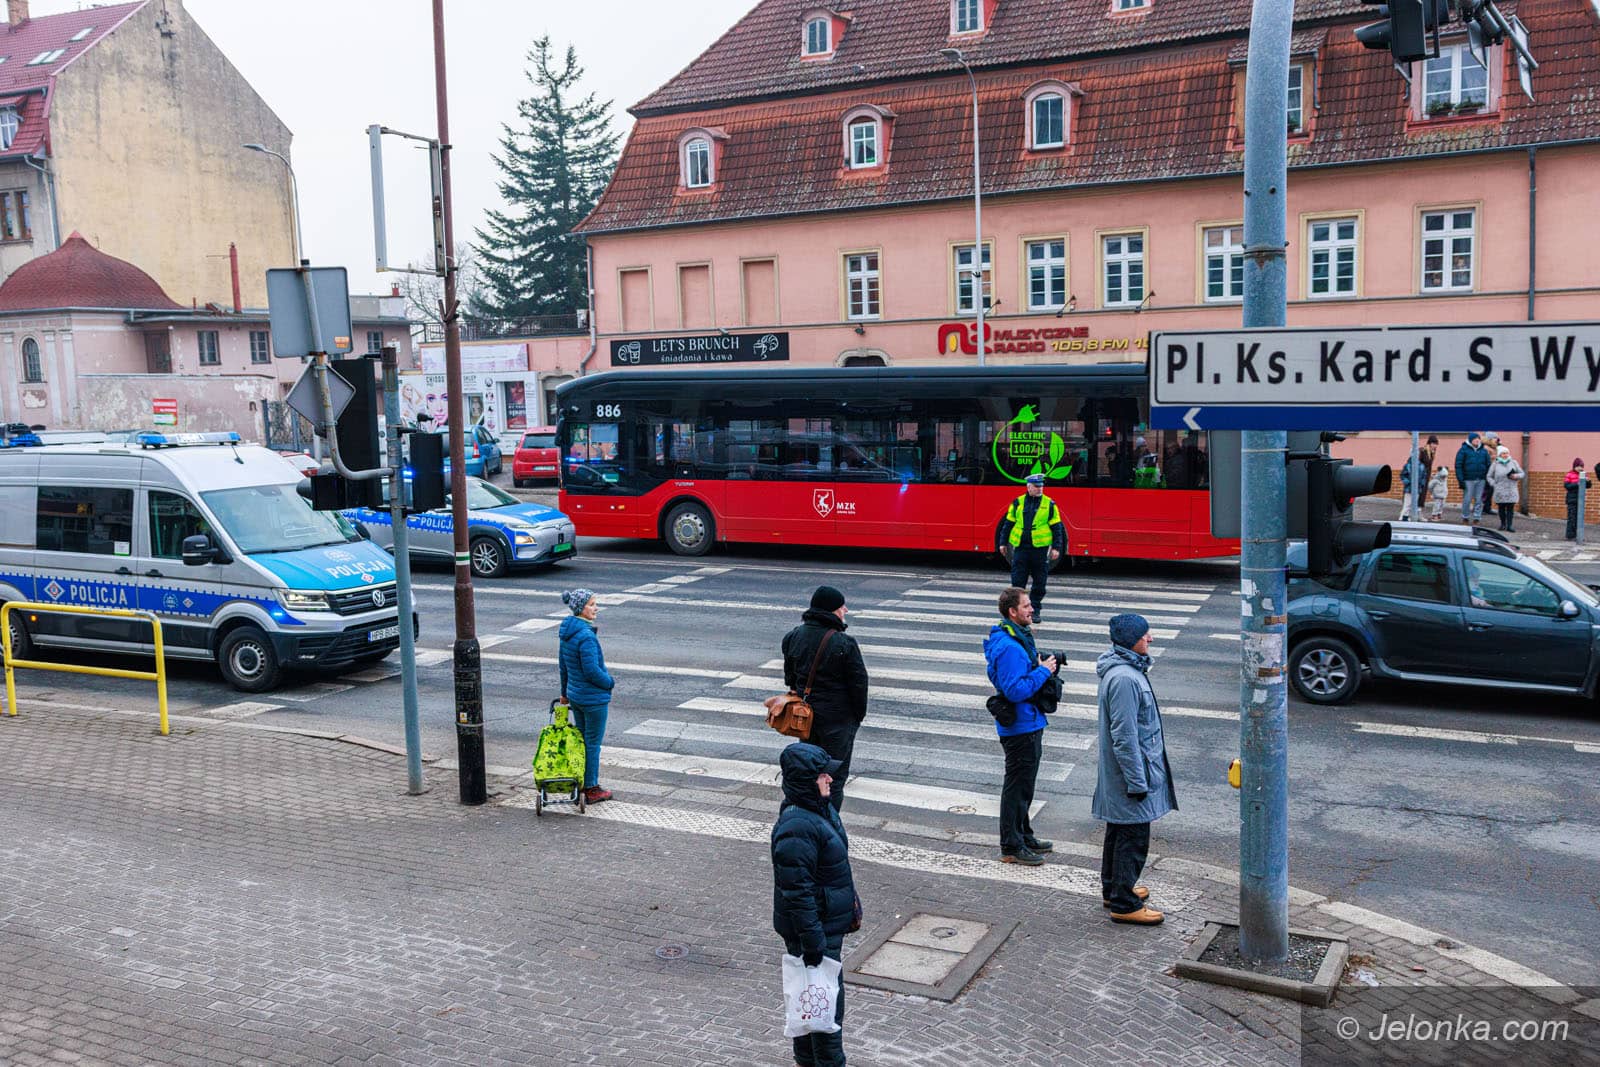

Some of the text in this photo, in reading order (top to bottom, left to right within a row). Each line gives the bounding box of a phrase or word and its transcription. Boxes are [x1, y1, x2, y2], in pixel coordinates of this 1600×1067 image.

[993, 327, 1090, 341] MUZYCZNE
[652, 336, 740, 353] LET'S BRUNCH
[993, 341, 1046, 354] RADIO
[1051, 338, 1099, 353] 105,8
[1100, 338, 1129, 351] FM
[710, 352, 734, 362] kawa
[1167, 342, 1221, 385] Pl.
[1236, 342, 1304, 386] Ks.
[1319, 336, 1451, 384] Kard.
[1466, 335, 1512, 382] S.
[596, 404, 622, 418] 886
[1008, 432, 1047, 440] ELECTRIC
[1013, 443, 1037, 454] 100%
[1017, 457, 1034, 465] BUS
[836, 502, 856, 510] MZK
[420, 516, 454, 530] POLICJ
[325, 560, 393, 579] POLICJA
[70, 584, 128, 605] POLICJA
